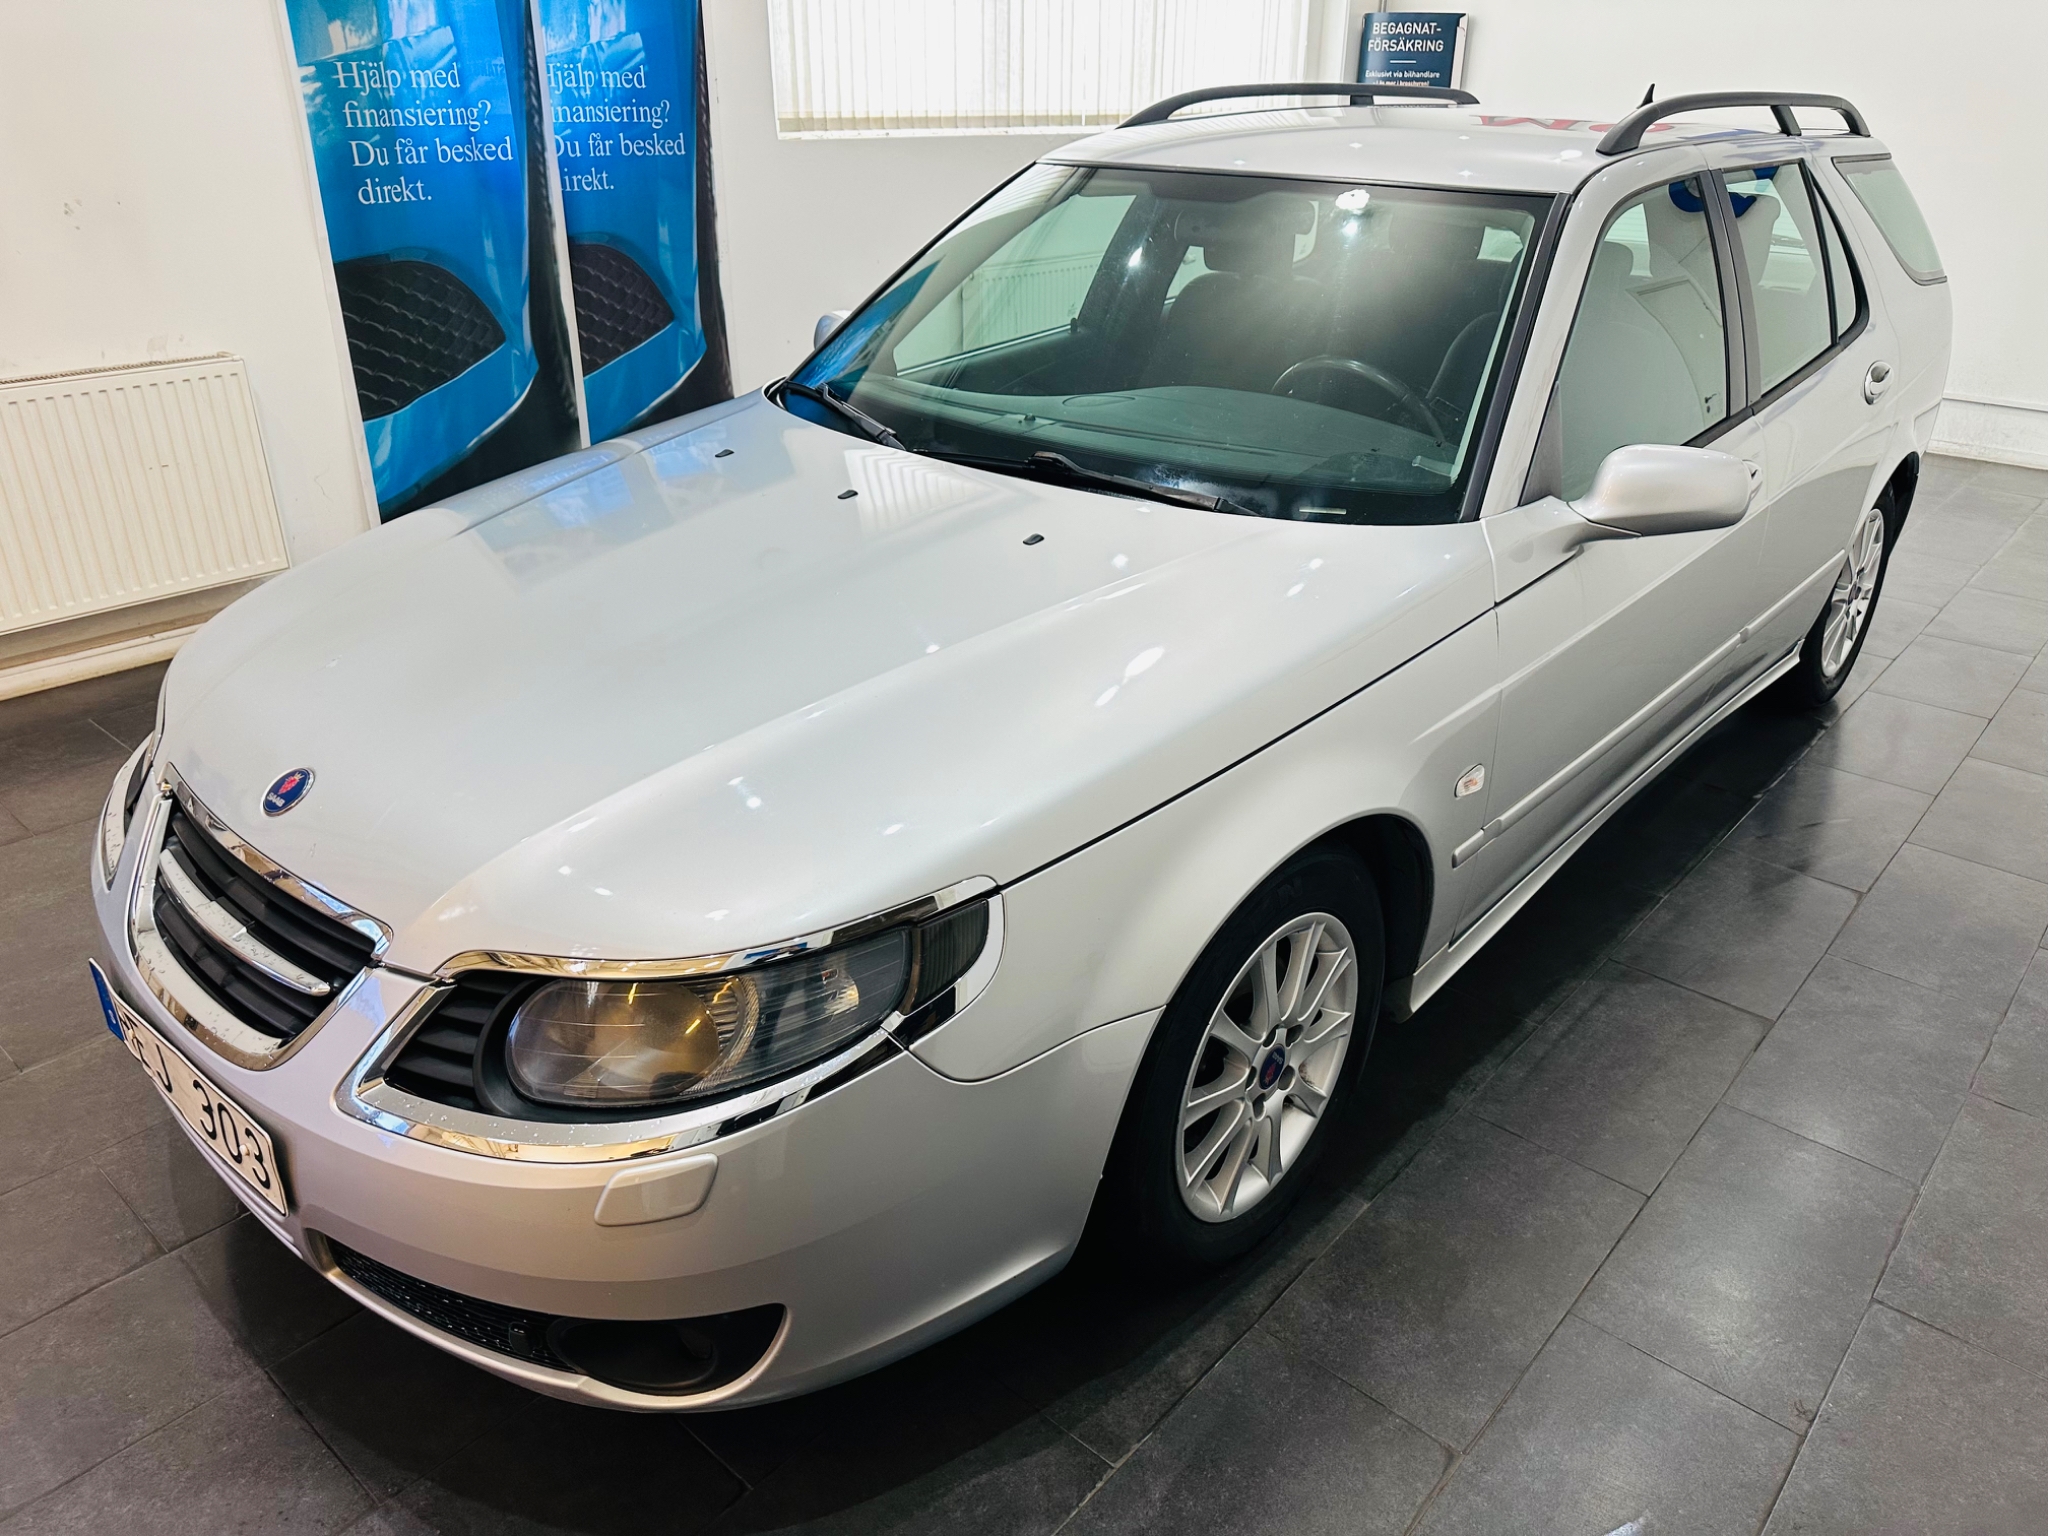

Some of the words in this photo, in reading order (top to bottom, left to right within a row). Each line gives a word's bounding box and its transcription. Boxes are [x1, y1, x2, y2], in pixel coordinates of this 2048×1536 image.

[1373, 22, 1441, 34] BEGAGNAT-
[1368, 37, 1444, 52] FÖRSÄKRING
[331, 61, 400, 96] Hjälp
[409, 62, 460, 88] med
[601, 65, 646, 88] med
[342, 99, 491, 132] finansiering?
[551, 98, 670, 129] inansiering?
[348, 140, 390, 167] Du
[394, 138, 428, 165] får
[434, 136, 514, 163] besked
[588, 133, 613, 156] får
[619, 132, 686, 156] besked
[358, 176, 432, 205] direkt.
[561, 167, 614, 191] irekt.
[267, 792, 286, 807] SAAB
[193, 1079, 271, 1189] 303
